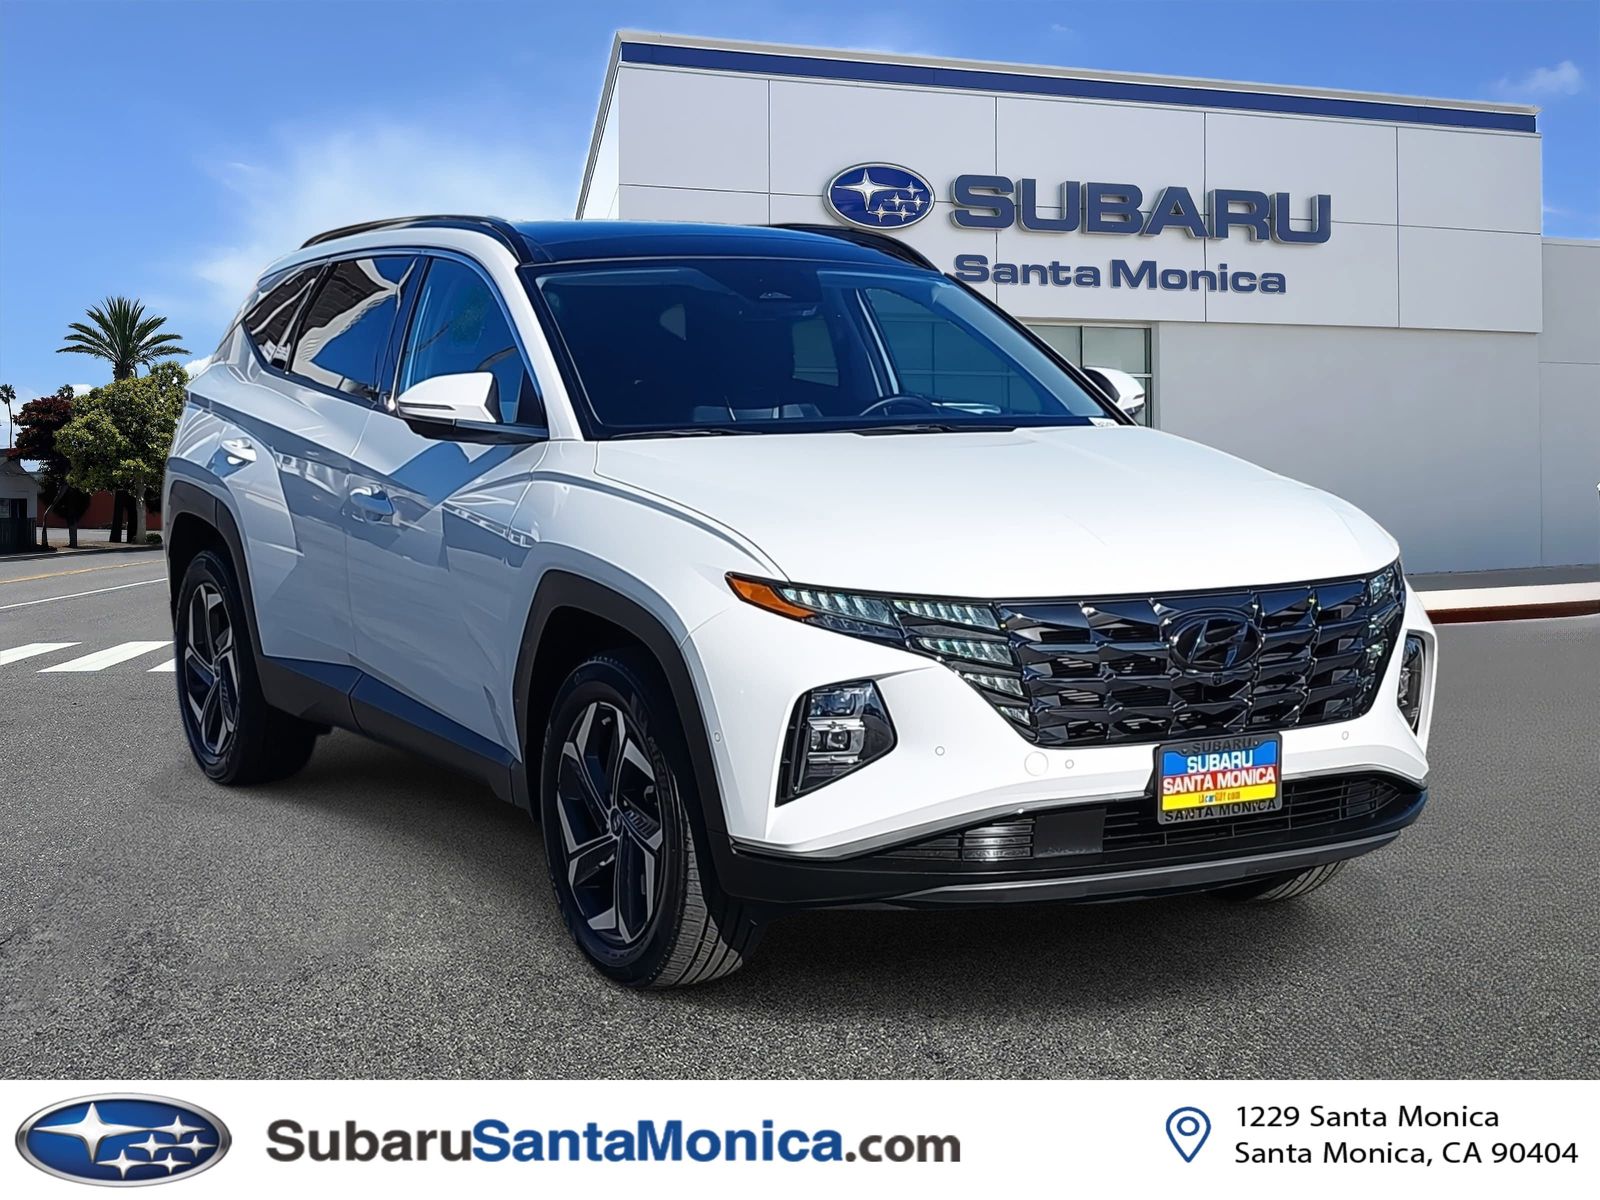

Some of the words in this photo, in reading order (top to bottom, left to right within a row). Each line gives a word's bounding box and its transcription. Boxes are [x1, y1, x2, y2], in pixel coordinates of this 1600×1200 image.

[951, 174, 1331, 244] SUBARU
[955, 254, 1100, 288] Santa
[1111, 259, 1287, 294] Monica
[1193, 737, 1254, 753] SUBARU
[1187, 750, 1254, 773] SUBARU
[1163, 774, 1215, 795] SANTA
[1217, 767, 1276, 790] MONICA
[1165, 806, 1215, 823] SANTA
[1219, 799, 1277, 816] MONICA
